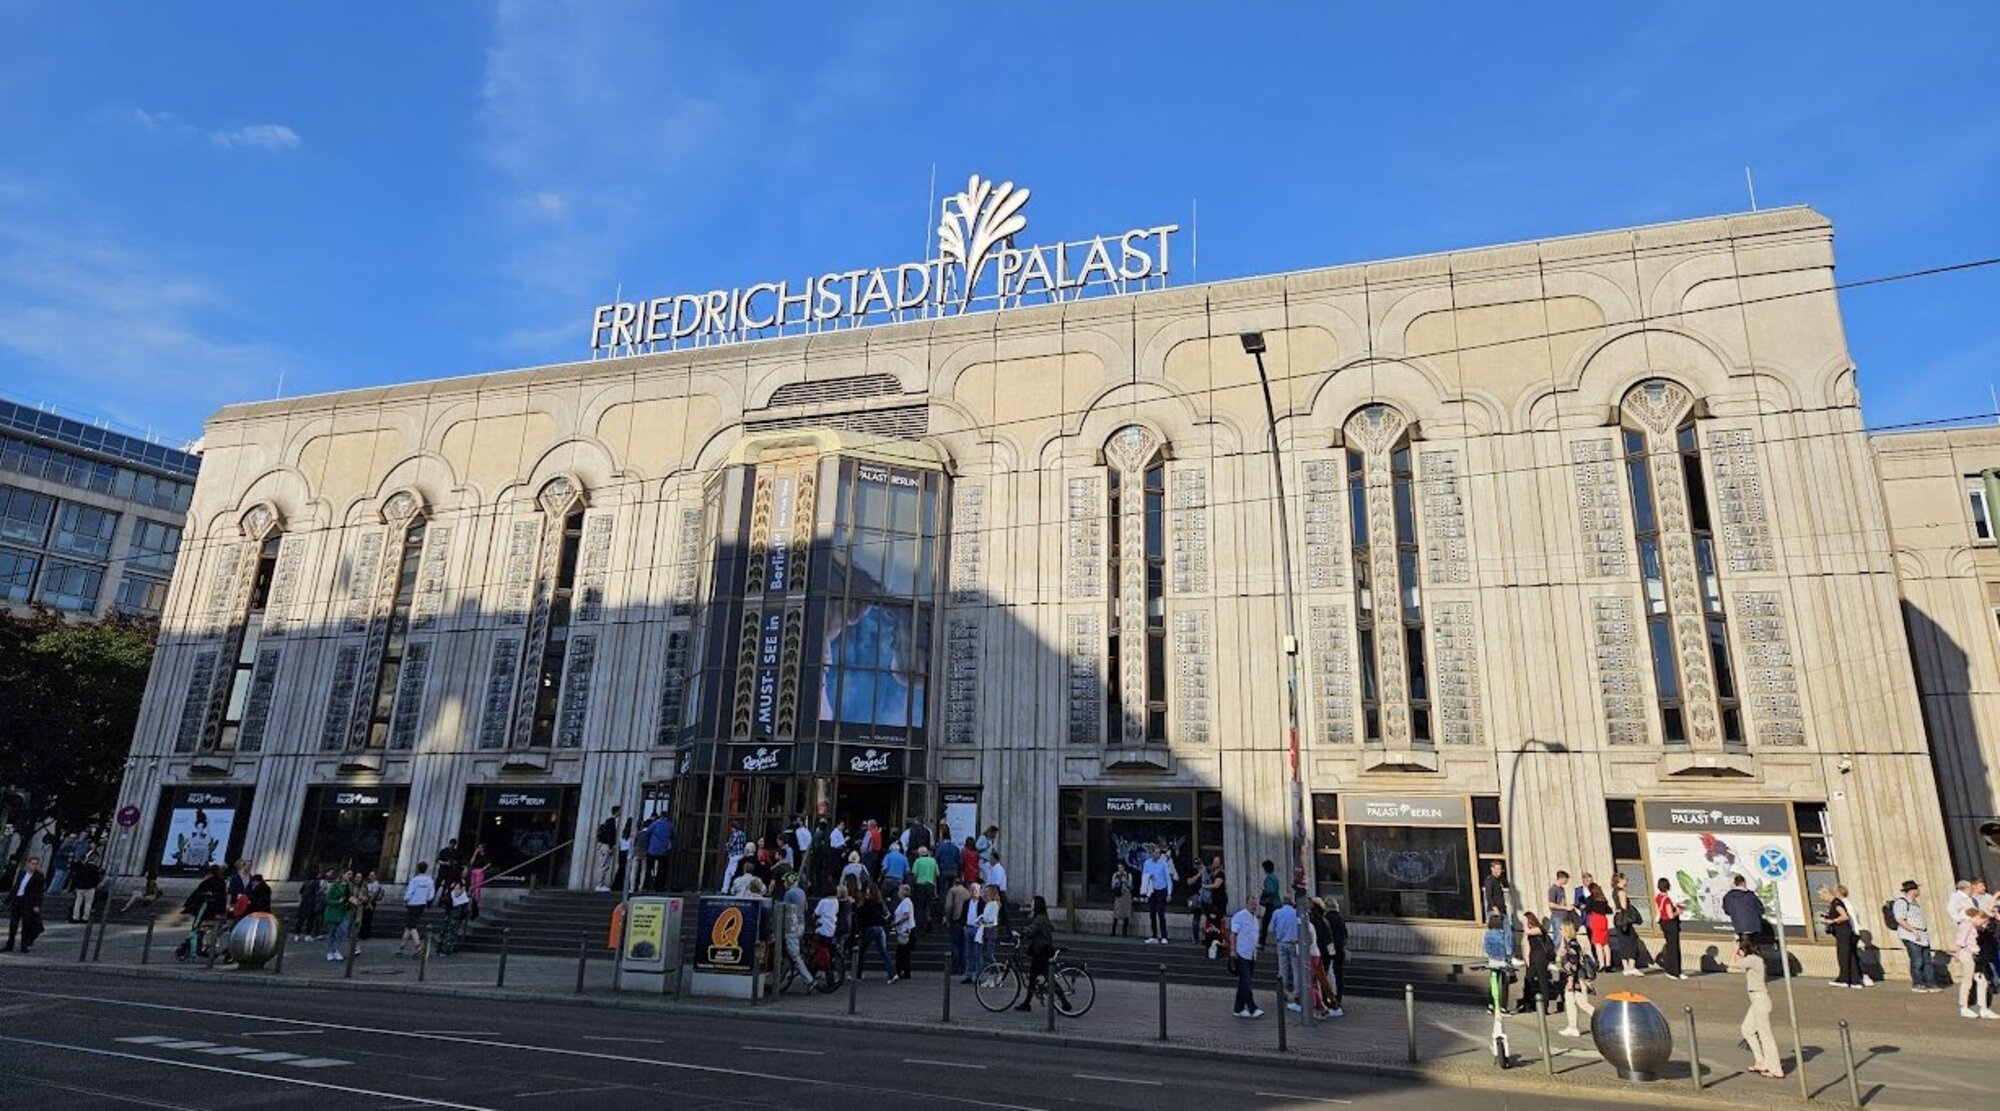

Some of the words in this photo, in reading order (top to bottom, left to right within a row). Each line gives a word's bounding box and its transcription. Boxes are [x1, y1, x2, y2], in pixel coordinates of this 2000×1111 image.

[591, 257, 956, 349] FRIEDRICHSTADT
[998, 224, 1179, 297] PALAST
[766, 615, 780, 631] in
[850, 752, 891, 773] Respect
[1106, 802, 1135, 811] PALAST
[1144, 802, 1172, 812] BERLIN
[1366, 807, 1399, 817] PALAST
[1410, 808, 1442, 818] BERLIN
[1671, 813, 1709, 825] PALAST
[1723, 815, 1760, 826] BERLIN
